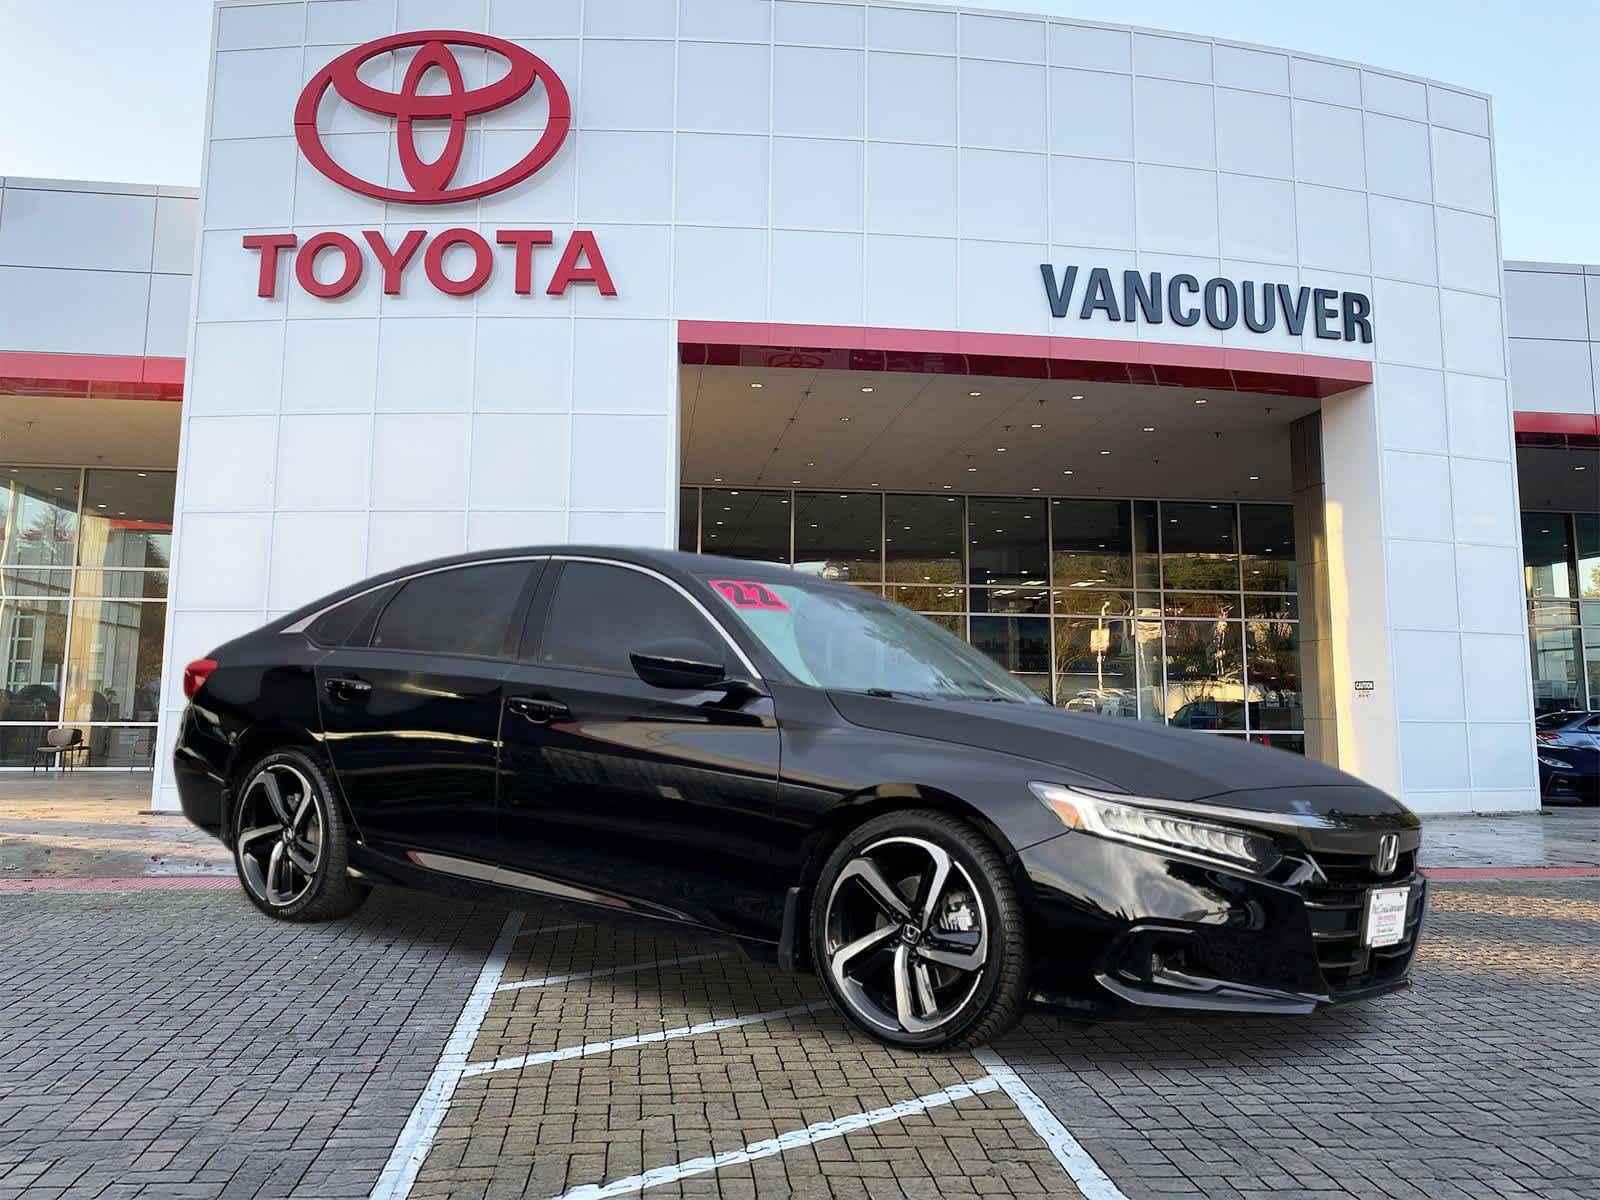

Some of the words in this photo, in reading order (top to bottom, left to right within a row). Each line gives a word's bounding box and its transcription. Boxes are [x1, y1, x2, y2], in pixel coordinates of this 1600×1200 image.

[243, 228, 618, 298] TOYOTA
[1040, 264, 1373, 343] VANCOUVER
[716, 582, 784, 606] 22
